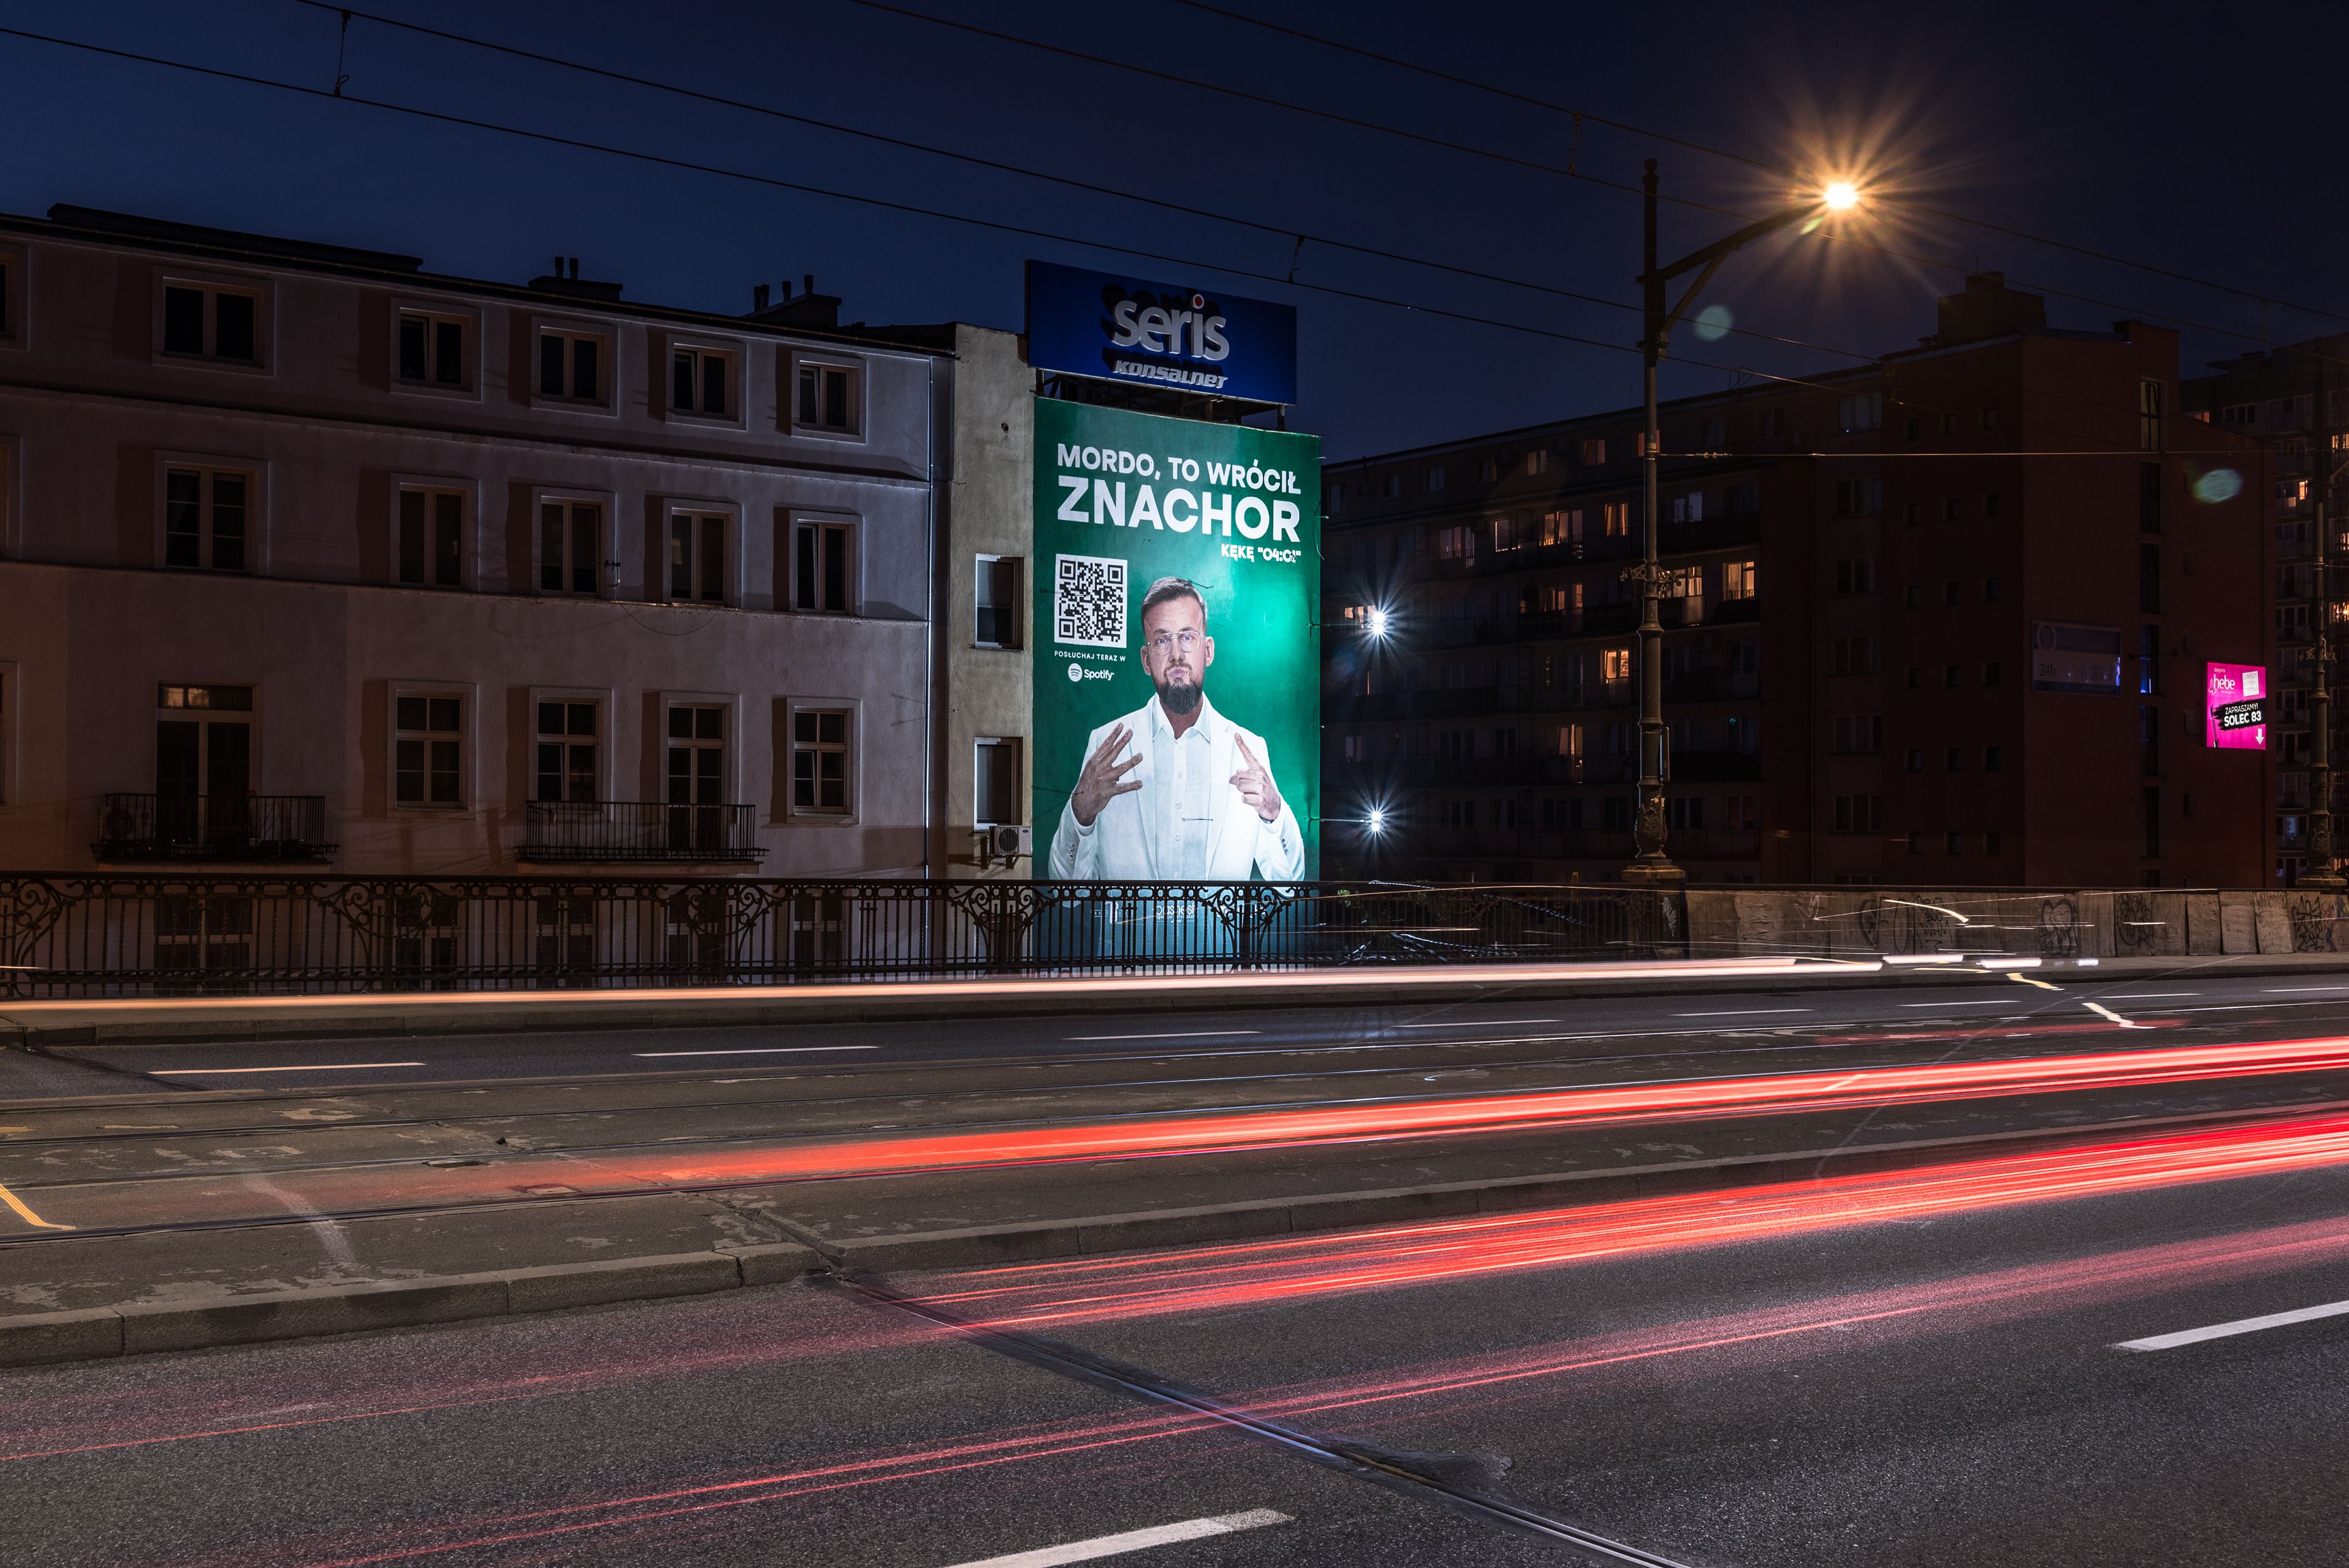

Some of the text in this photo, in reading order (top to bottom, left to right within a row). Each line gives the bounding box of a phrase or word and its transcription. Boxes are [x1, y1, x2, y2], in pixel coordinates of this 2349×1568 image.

[1111, 294, 1230, 361] seris
[1057, 443, 1302, 494] MORDO, TO WRÓCIŁ
[1057, 475, 1300, 543] ZNACHOR
[1221, 543, 1255, 563] KĘKĘ
[1054, 650, 1095, 660] POSŁUCHAJ
[1096, 653, 1117, 662] TERAZ
[1084, 668, 1114, 681] Spotify
[2214, 673, 2236, 690] hebe
[2225, 702, 2259, 715] ZAPRASZAMY!
[2224, 710, 2262, 727] SOLEC 83
